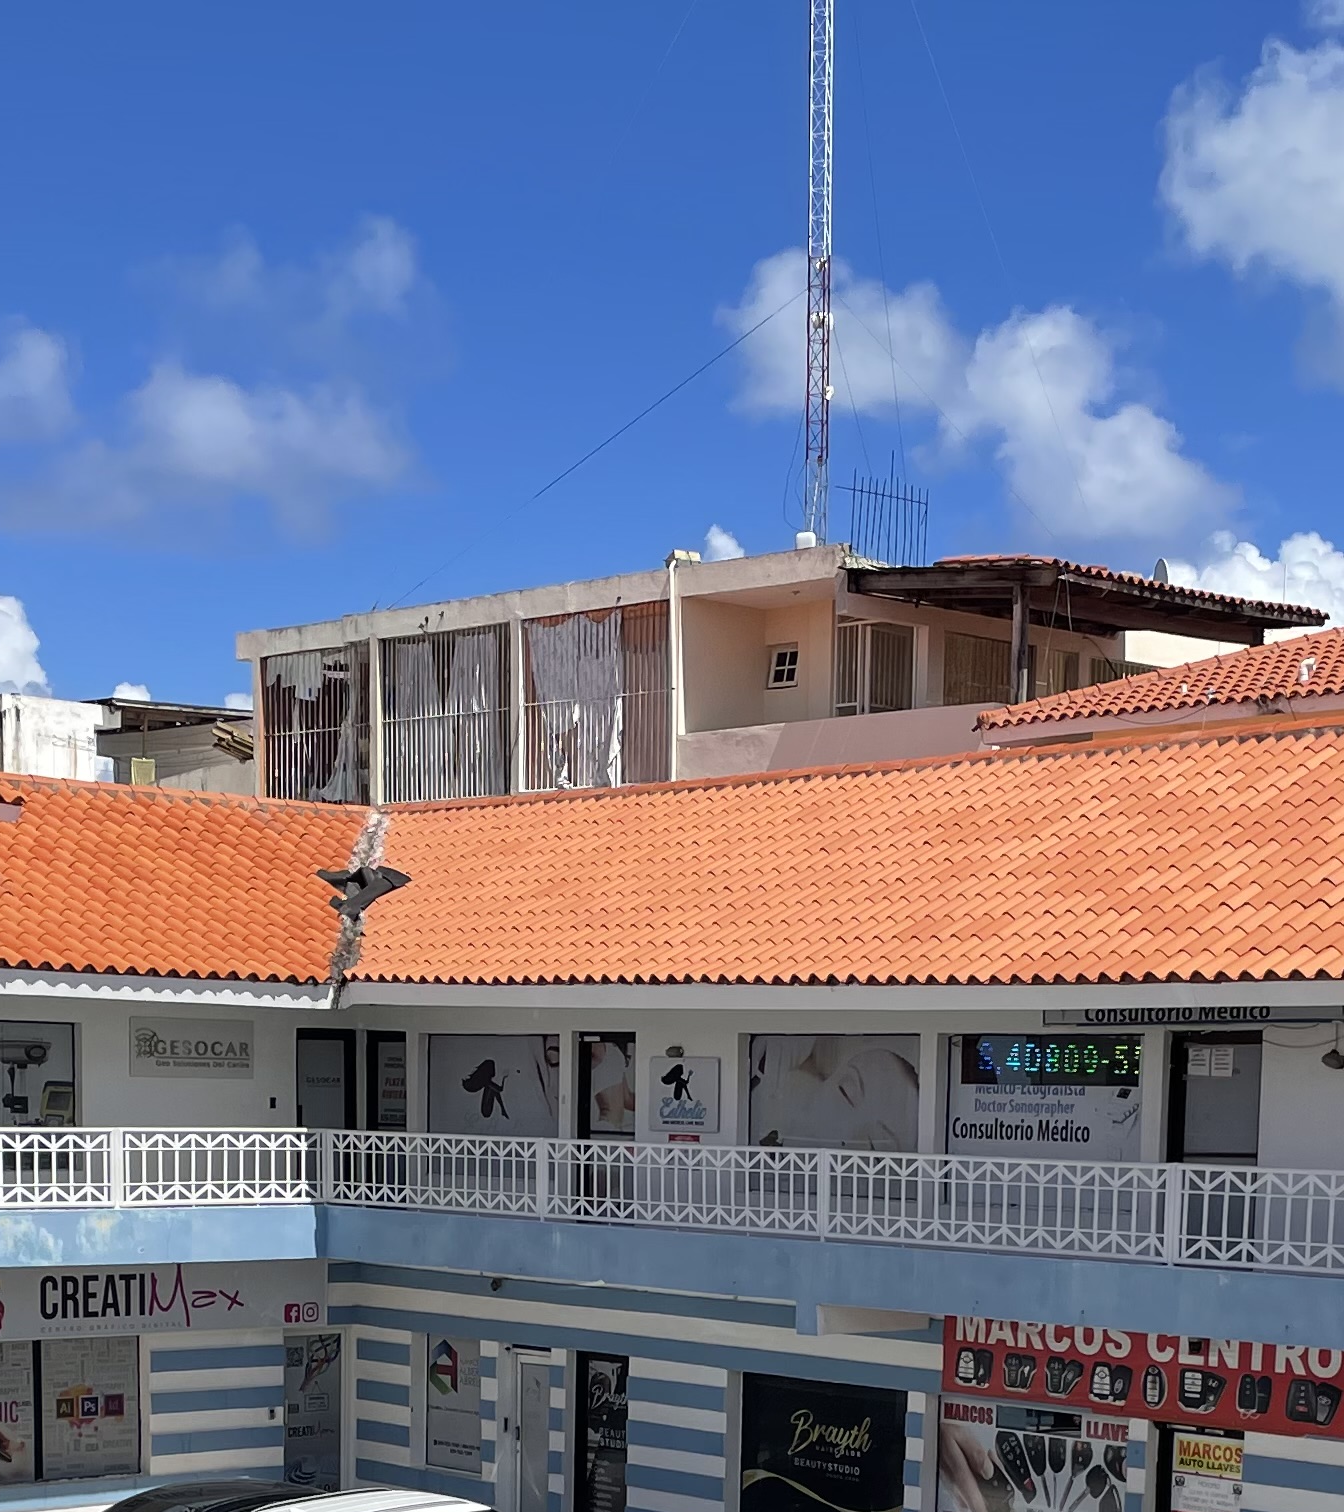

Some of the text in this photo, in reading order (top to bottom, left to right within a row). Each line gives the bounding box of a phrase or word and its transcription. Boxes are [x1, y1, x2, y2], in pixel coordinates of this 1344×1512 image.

[156, 1040, 250, 1056] GESOCAR
[974, 1098, 1075, 1116] Doctor Sonographer
[952, 1117, 1090, 1143] Consultorio Médico
[955, 1316, 1133, 1359] MARCOS
[1147, 1333, 1343, 1378] CENTRO
[83, 1401, 96, 1412] Ps
[943, 1402, 993, 1426] MARCOS
[788, 1409, 872, 1458] Brayth
[1178, 1438, 1243, 1465] MARCOS
[1178, 1457, 1241, 1475] AUTO LLAVES
